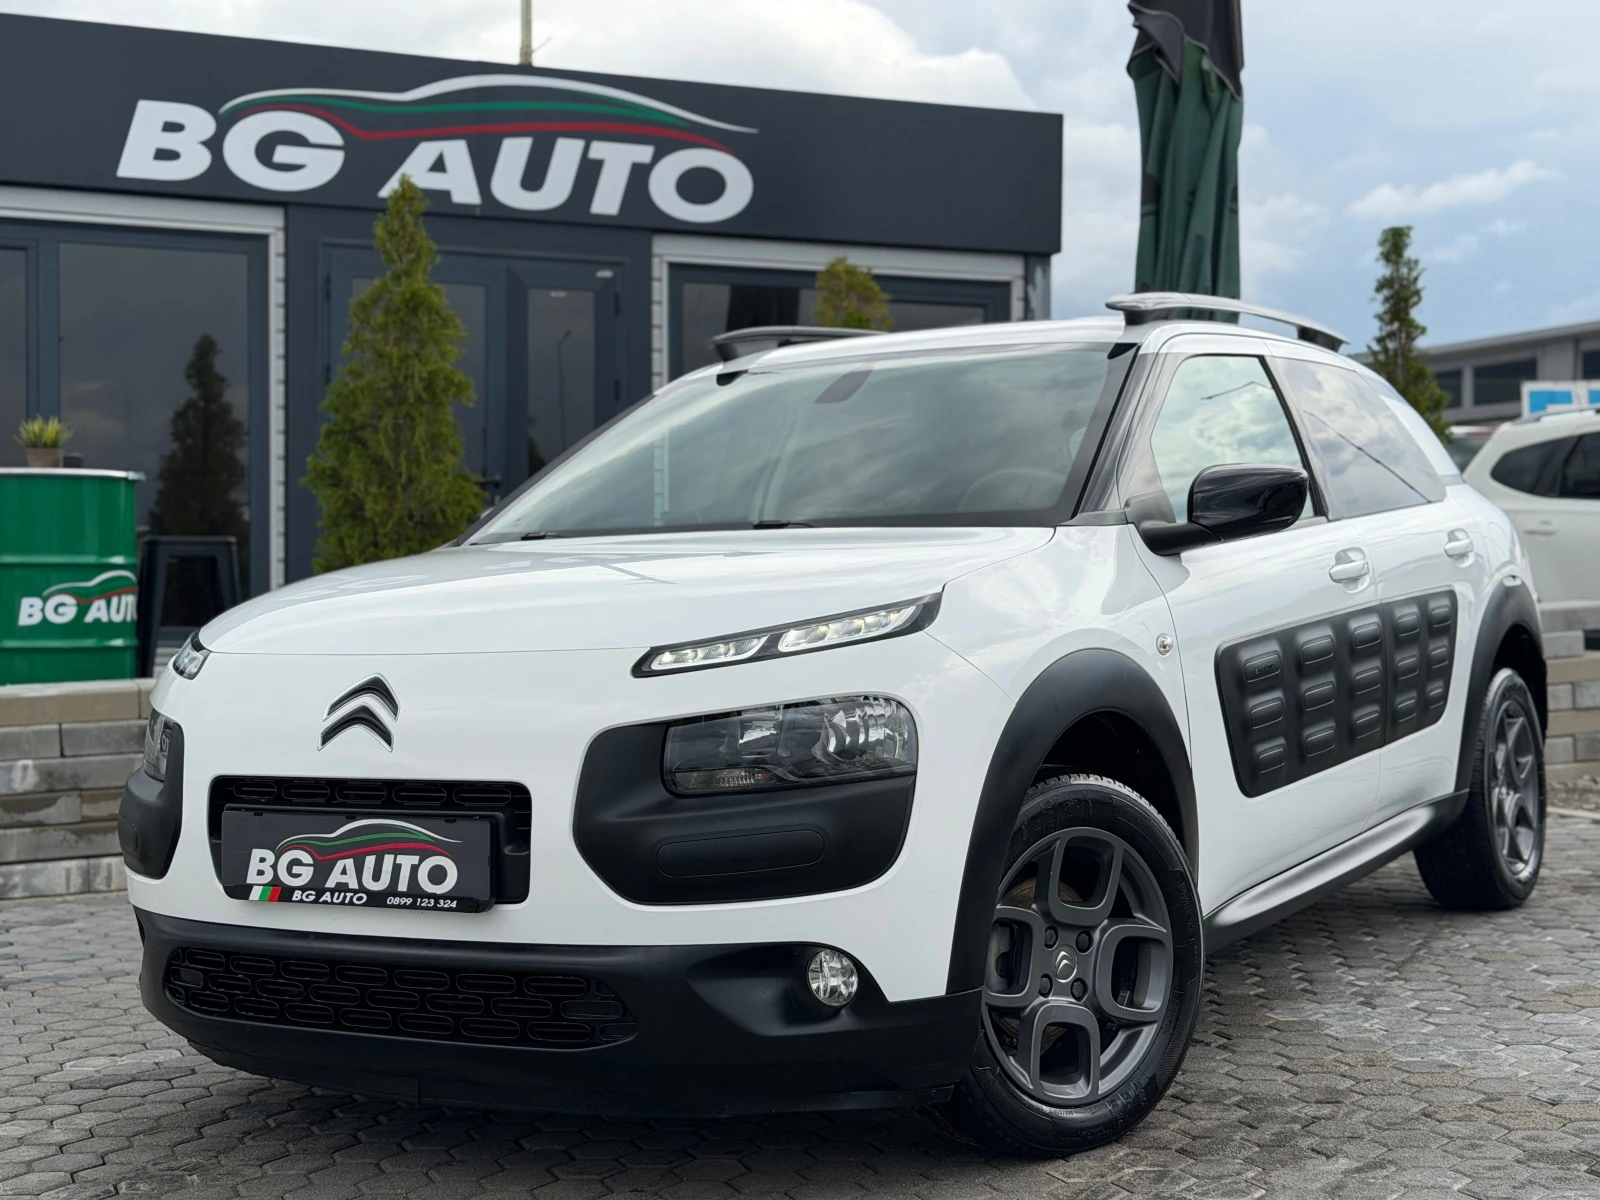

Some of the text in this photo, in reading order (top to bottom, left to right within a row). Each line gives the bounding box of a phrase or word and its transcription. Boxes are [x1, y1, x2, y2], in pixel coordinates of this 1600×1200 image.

[116, 98, 754, 223] BG AUTO
[18, 594, 137, 626] BG AUT
[246, 848, 458, 894] BG AUTO
[292, 890, 457, 908] BG AUTO 0899 123 324
